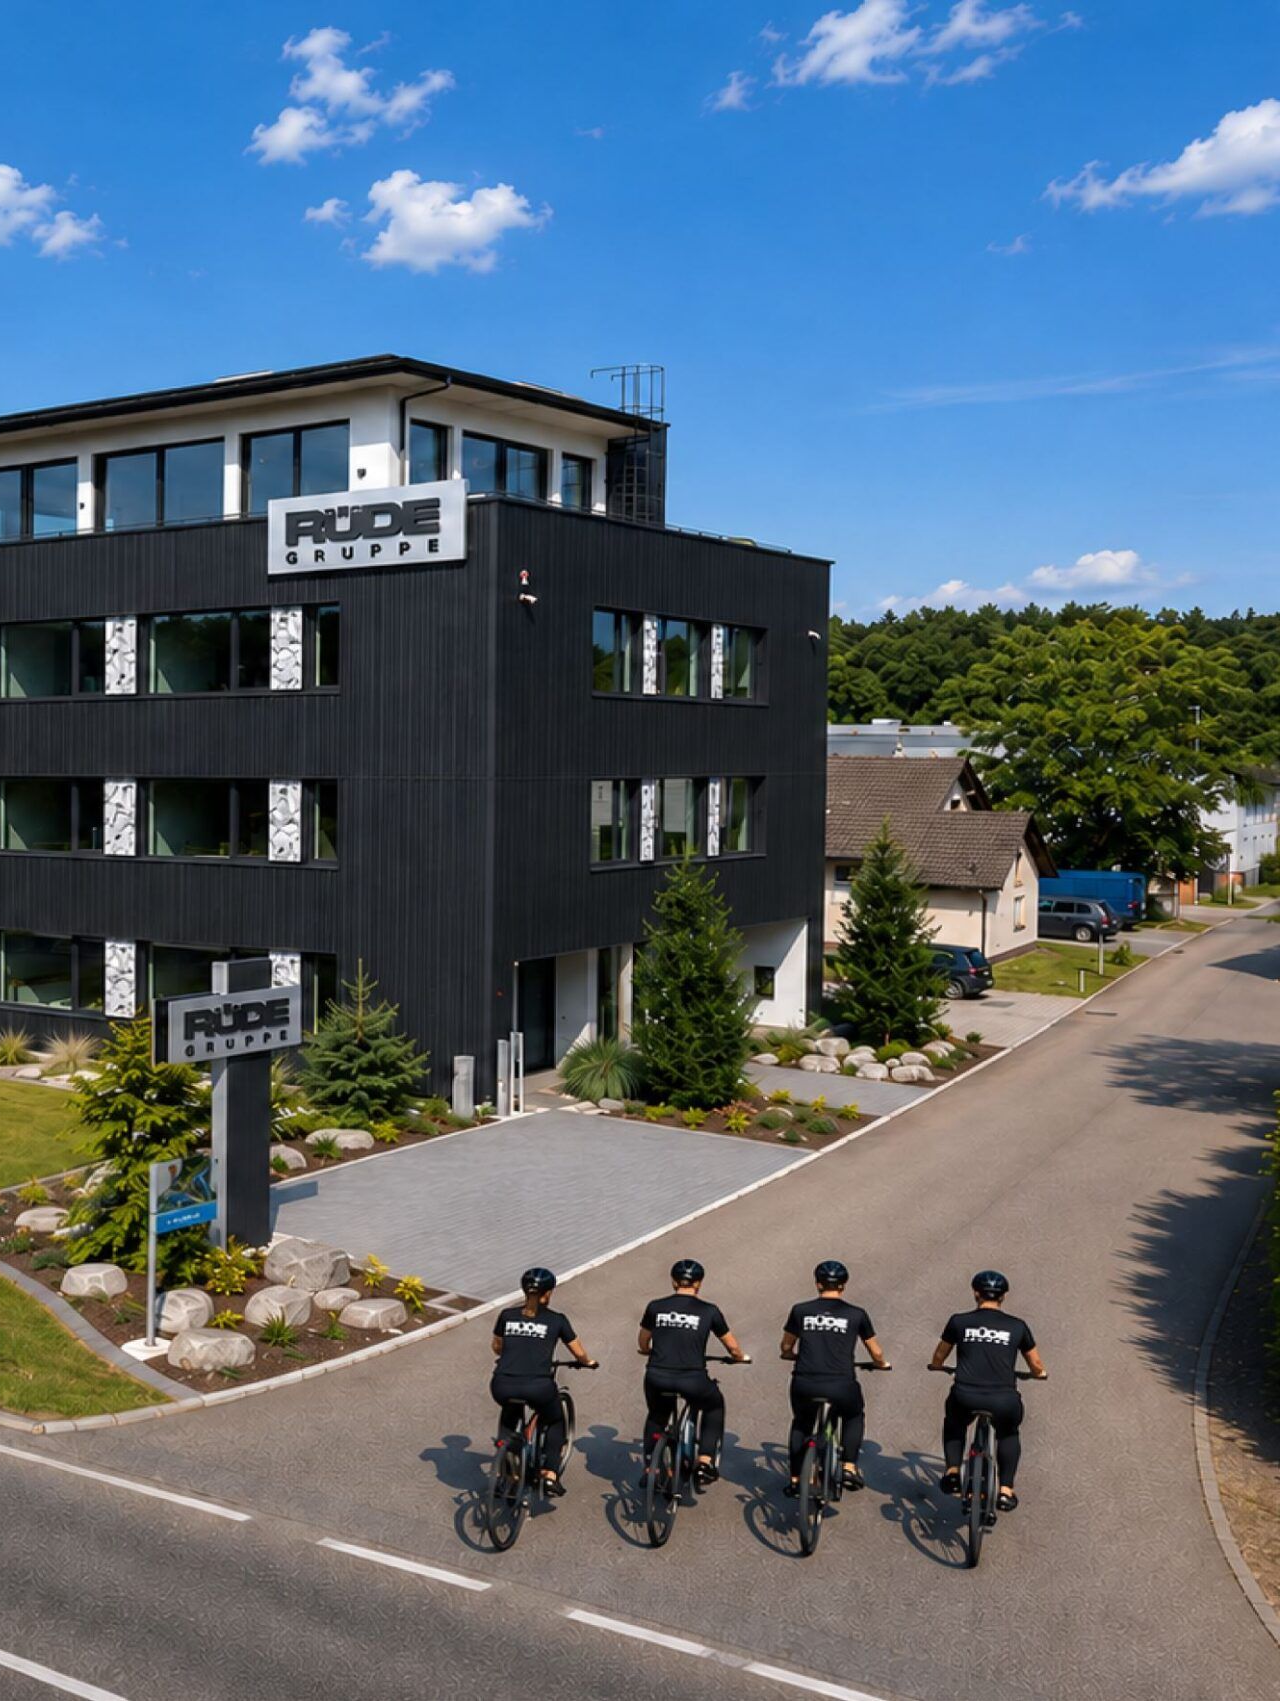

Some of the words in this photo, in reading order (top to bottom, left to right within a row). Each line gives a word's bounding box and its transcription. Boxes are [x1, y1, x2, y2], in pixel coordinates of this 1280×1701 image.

[285, 497, 440, 547] RÜDE
[285, 538, 439, 564] GRUPPE
[184, 997, 290, 1040] RÜDE
[185, 1029, 288, 1057] GRUPPE
